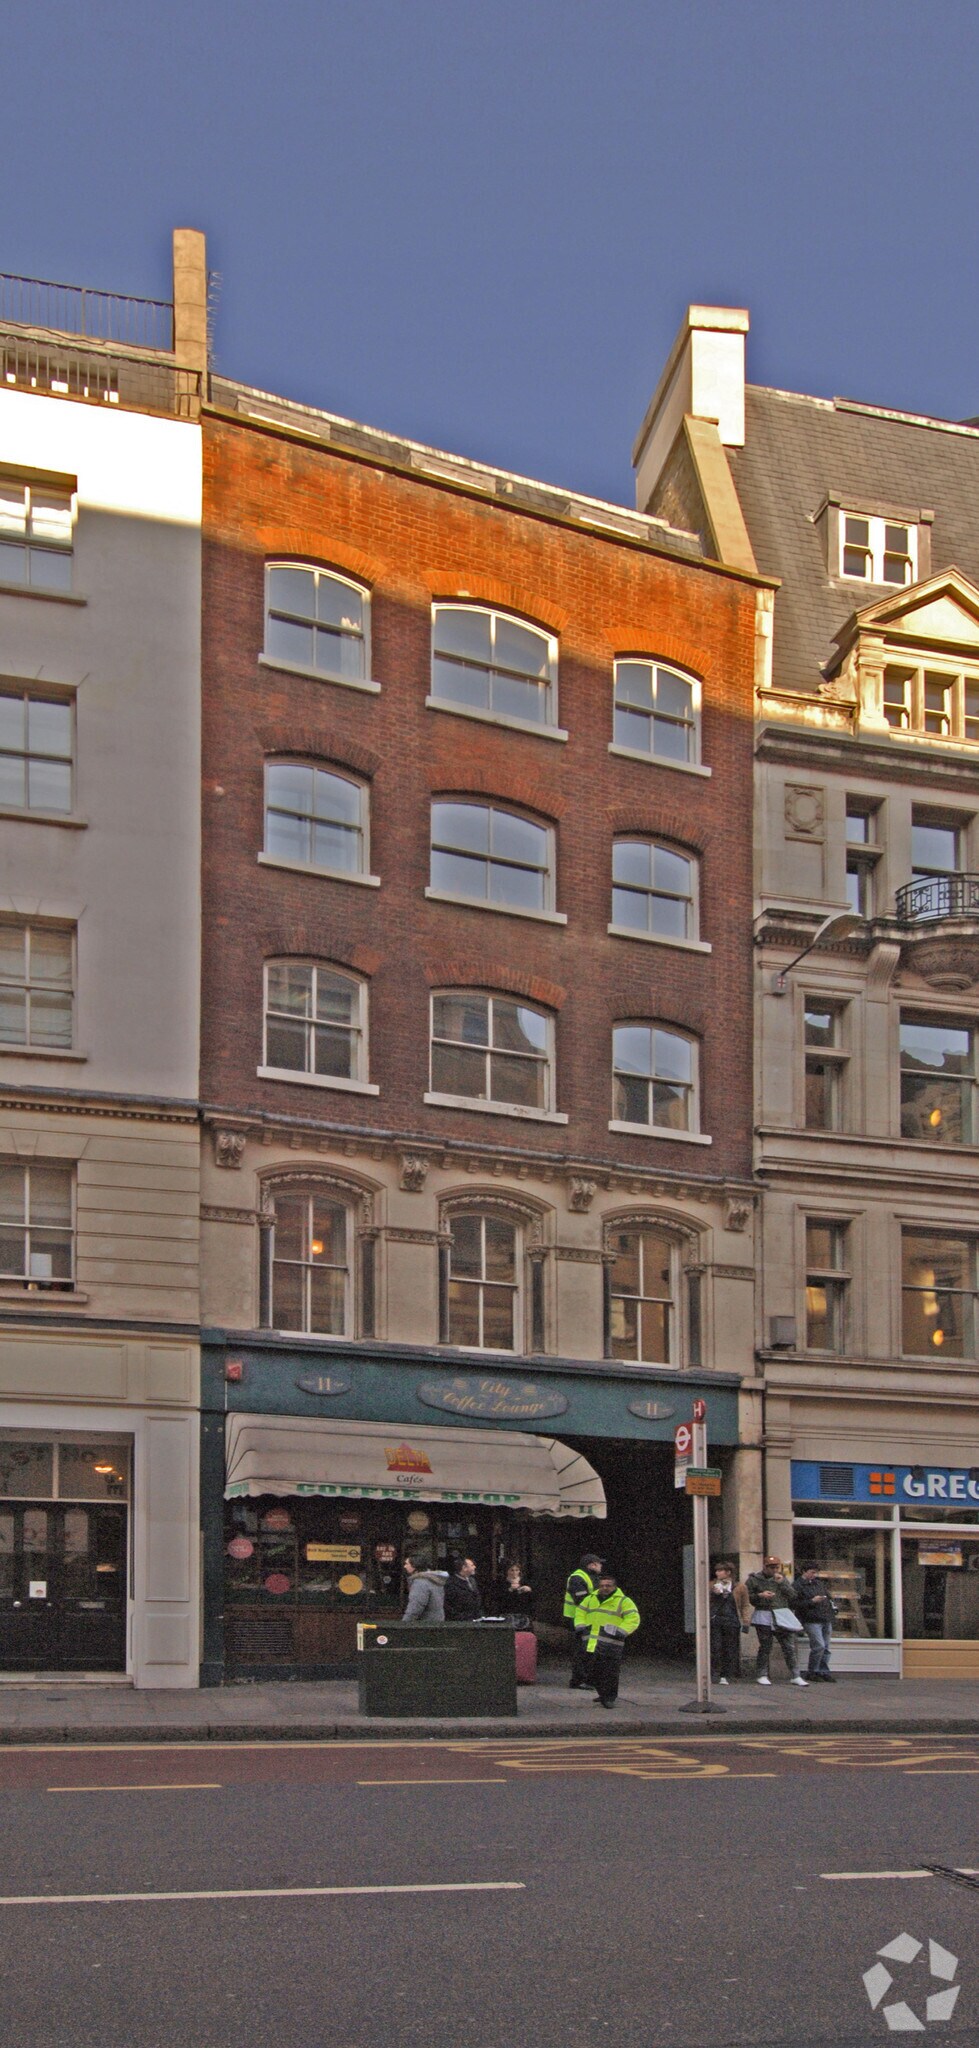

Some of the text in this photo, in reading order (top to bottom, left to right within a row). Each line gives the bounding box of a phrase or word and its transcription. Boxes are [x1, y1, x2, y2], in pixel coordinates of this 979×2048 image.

[481, 1381, 511, 1397] City
[443, 1393, 545, 1416] Coffee Lounge
[693, 1402, 702, 1417] H
[384, 1447, 431, 1467] DELTA
[296, 1483, 520, 1504] COFFEE SHOP
[447, 1744, 730, 1776] STOP
[738, 1739, 979, 1766] BUS
